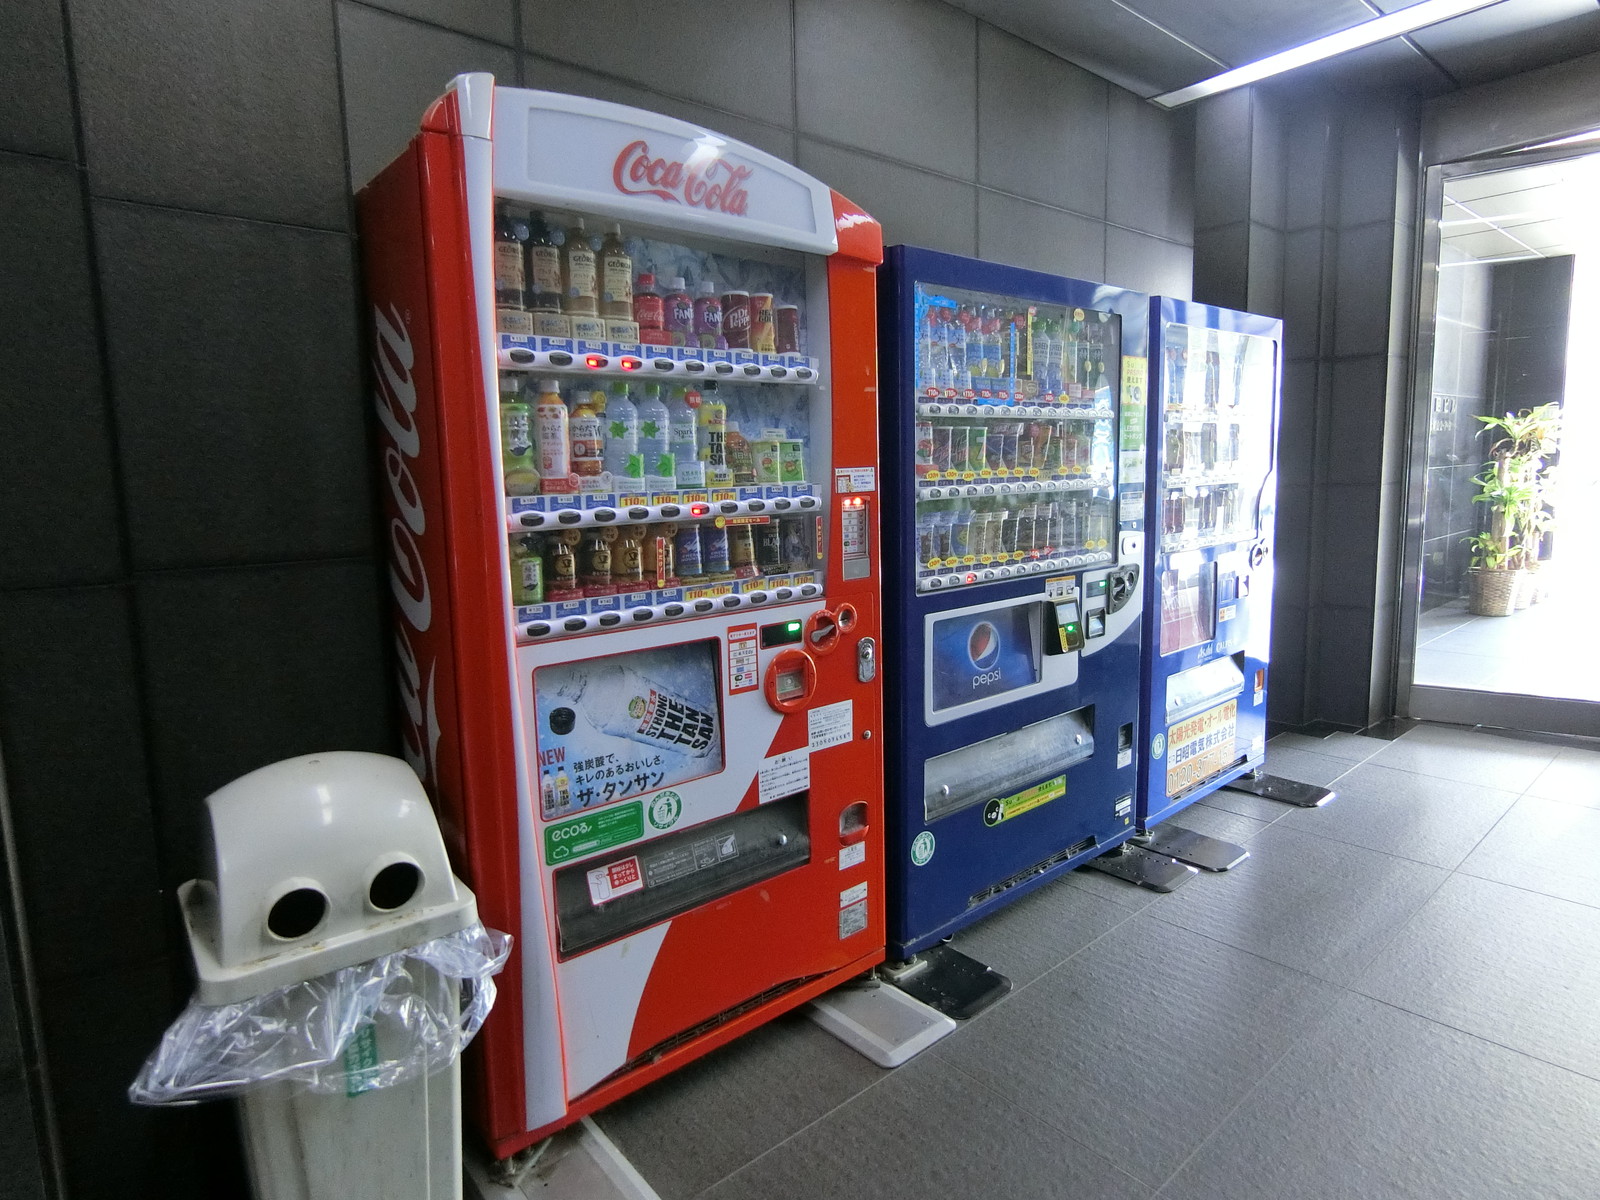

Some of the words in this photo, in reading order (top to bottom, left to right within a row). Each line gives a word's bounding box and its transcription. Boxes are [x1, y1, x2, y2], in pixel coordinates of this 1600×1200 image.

[972, 667, 1001, 689] pepsi
[645, 693, 667, 737] STRONG
[656, 698, 685, 741] THE
[673, 705, 701, 746] TAN
[691, 711, 714, 750] SAN
[1169, 703, 1235, 748] 太陽光発電・オール電化
[540, 746, 566, 767] NEW
[573, 753, 620, 774] 強炭酸で、
[575, 754, 665, 786] キレのあるおいしさ。
[577, 771, 665, 807] ザ・タンサン
